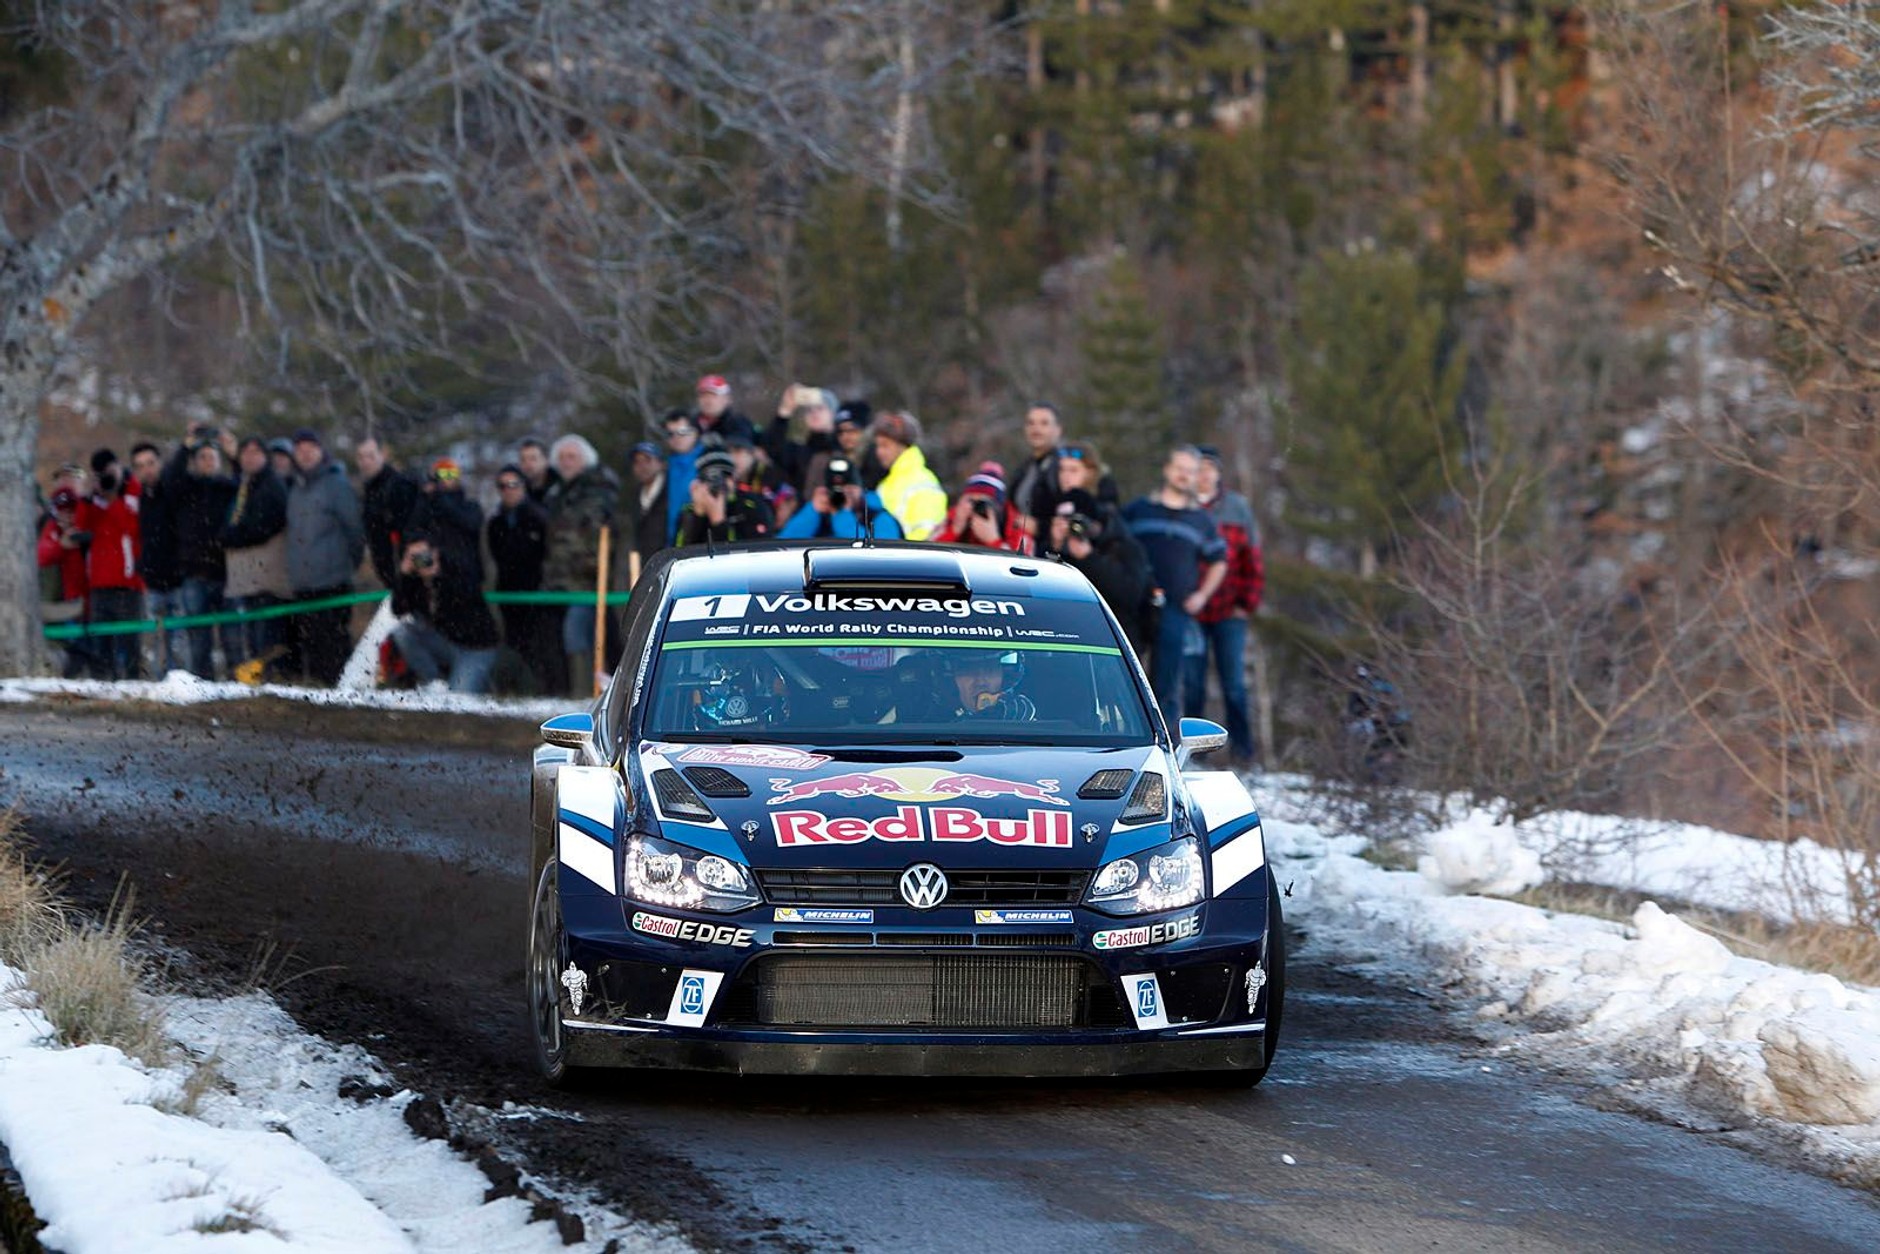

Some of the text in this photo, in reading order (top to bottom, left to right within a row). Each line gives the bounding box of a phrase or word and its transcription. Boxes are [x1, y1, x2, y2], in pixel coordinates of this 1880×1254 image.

[703, 597, 722, 617] 1
[755, 593, 1026, 618] Volkswagen
[752, 624, 781, 634] FIA
[785, 623, 834, 634] World
[839, 623, 882, 635] Rally
[886, 623, 1004, 637] Championship
[773, 807, 1071, 846] Red Bull
[803, 910, 871, 920] MICHELIN
[1004, 911, 1071, 921] MICHELIN
[641, 914, 757, 948] Castrol EDGE
[1107, 916, 1200, 947] Castrol EDGE
[683, 985, 703, 1006] ZF
[1139, 987, 1155, 1009] ZF
